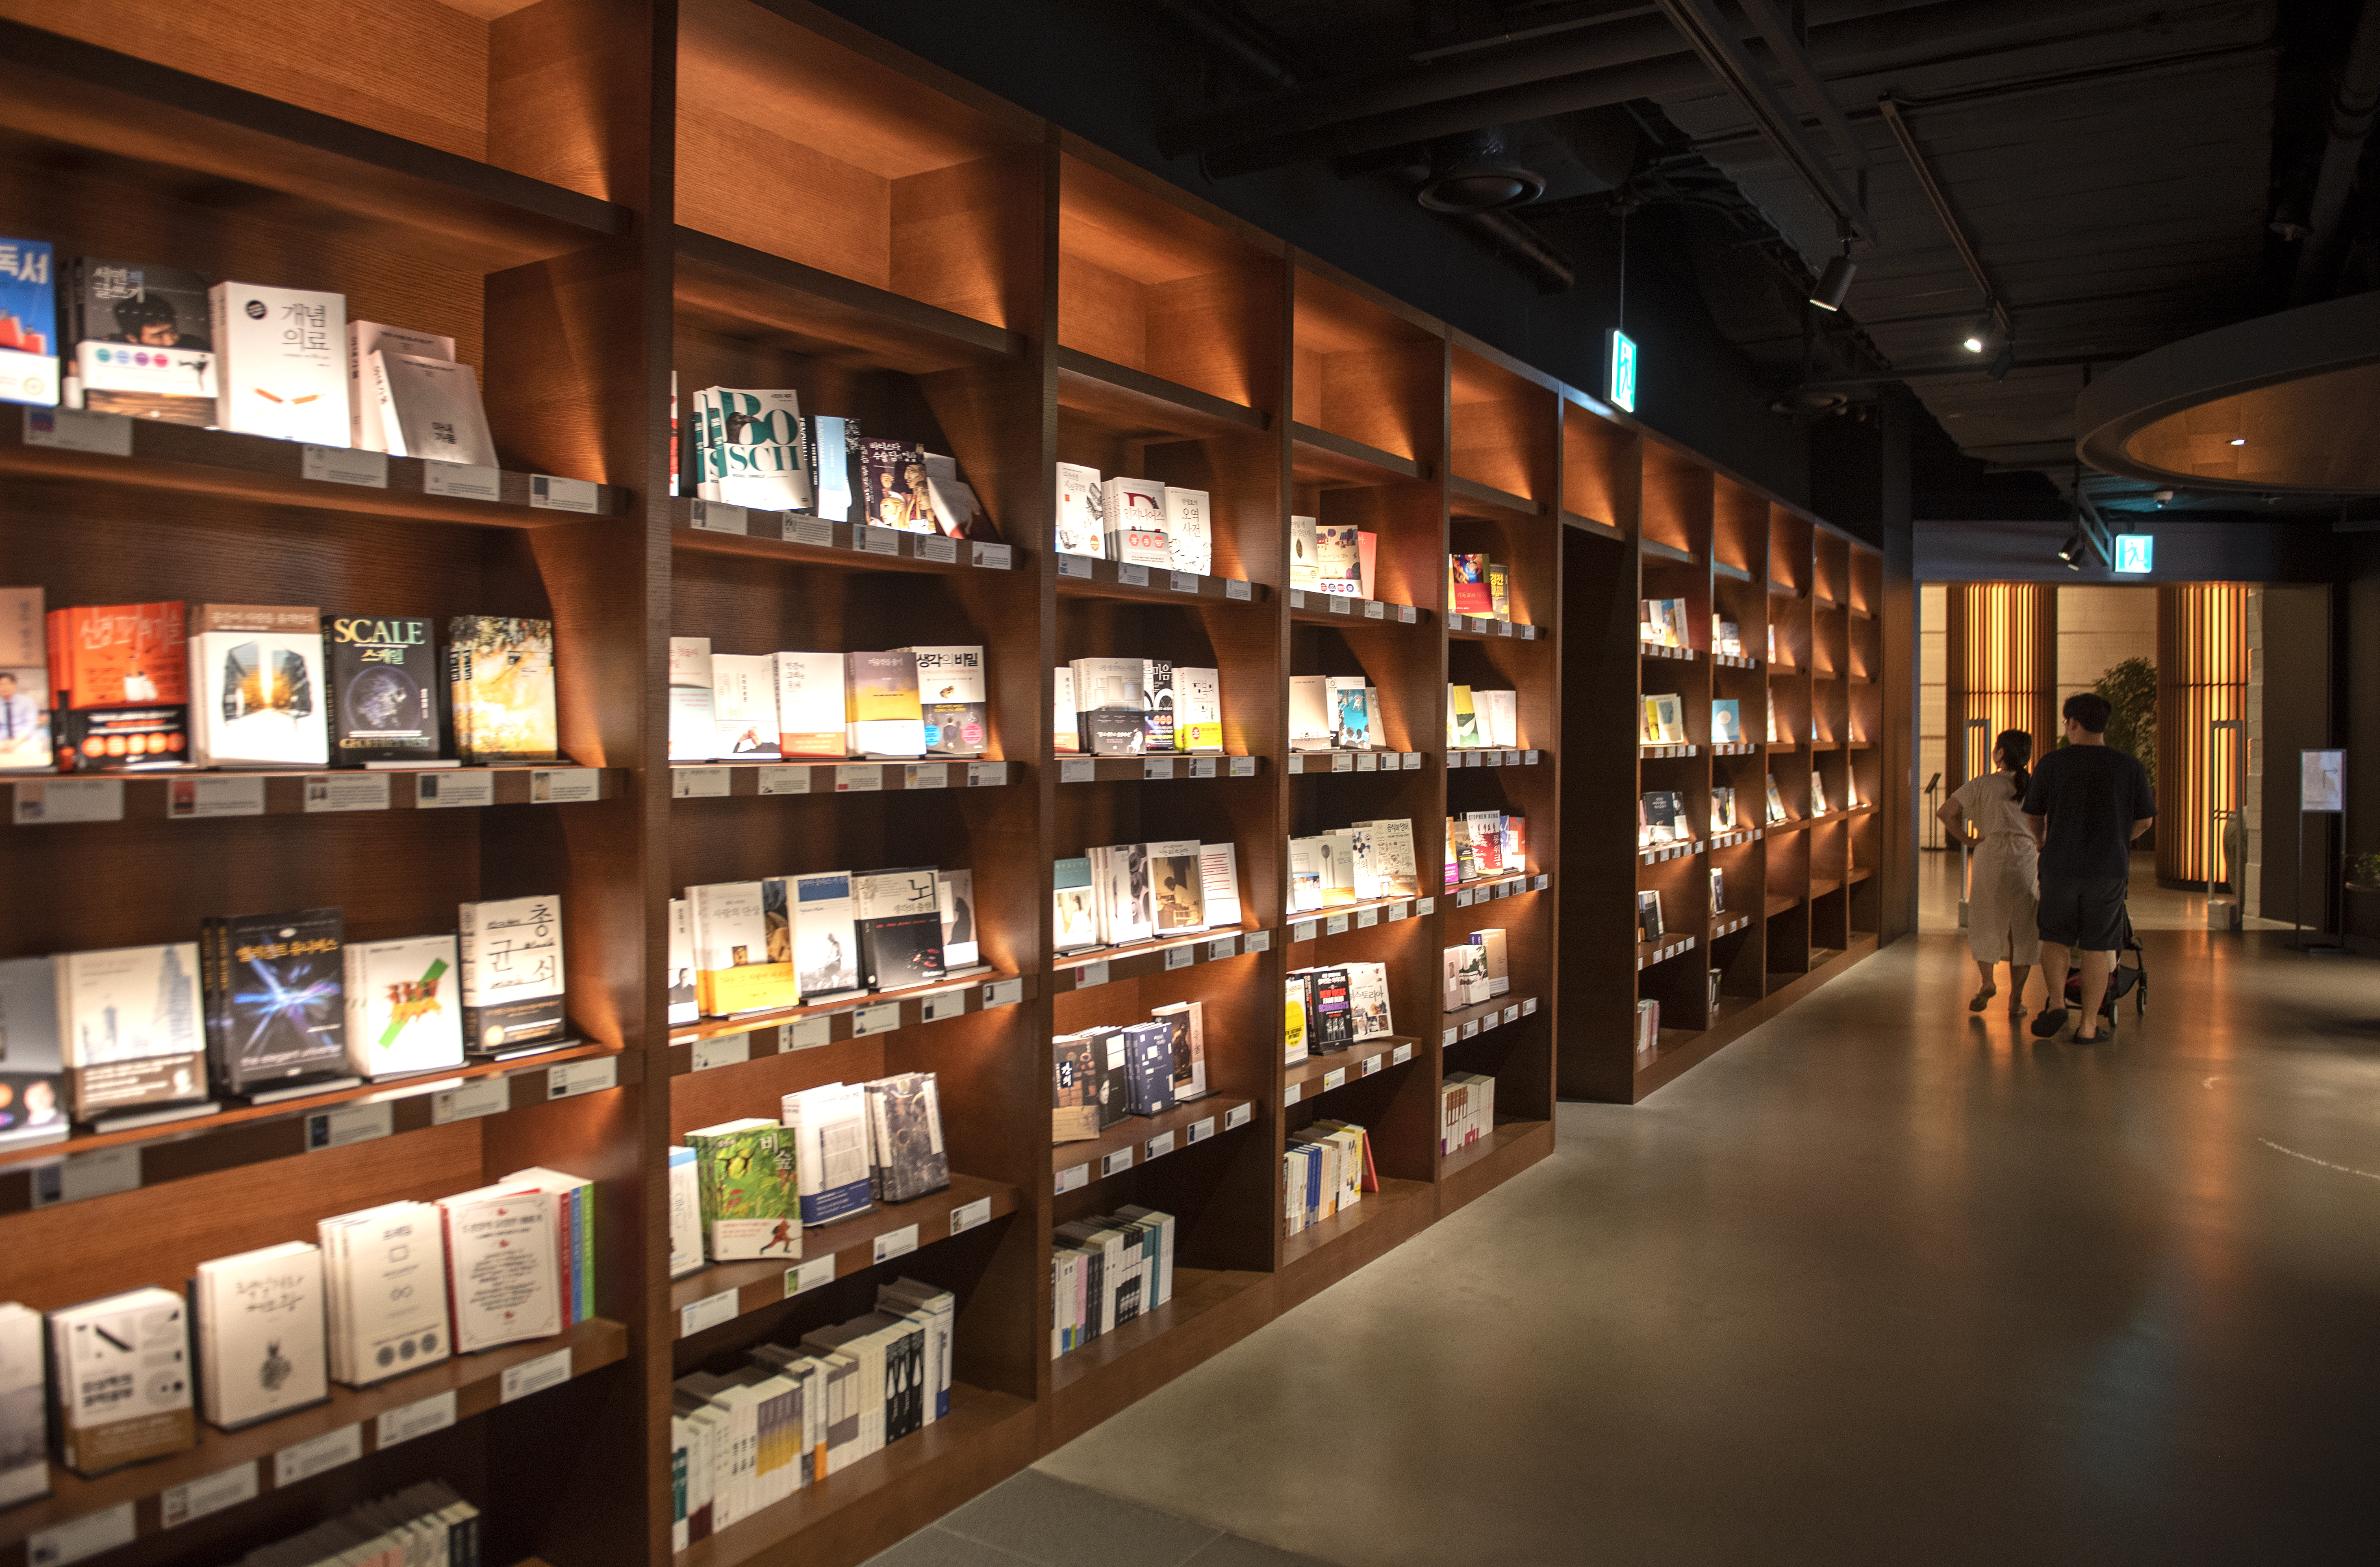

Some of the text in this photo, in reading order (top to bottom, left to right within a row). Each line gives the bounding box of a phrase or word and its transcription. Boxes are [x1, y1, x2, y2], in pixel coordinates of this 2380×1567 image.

[280, 303, 325, 328] 개념
[282, 328, 330, 352] 의료
[869, 442, 901, 451] 바티스타
[1123, 507, 1166, 523] 인지니어스
[1181, 507, 1199, 523] 오역
[1182, 522, 1201, 538] 사전
[1490, 573, 1504, 586] 경전
[333, 618, 426, 644] SCALE
[360, 648, 405, 664] 스케일
[954, 652, 979, 667] 비밀
[1153, 663, 1172, 681] 마음
[907, 872, 937, 910] 뇌
[528, 904, 554, 937] 총
[489, 939, 513, 972] 균
[530, 955, 556, 989] 쇠
[760, 1132, 778, 1153] 비
[773, 1150, 793, 1171] 숲
